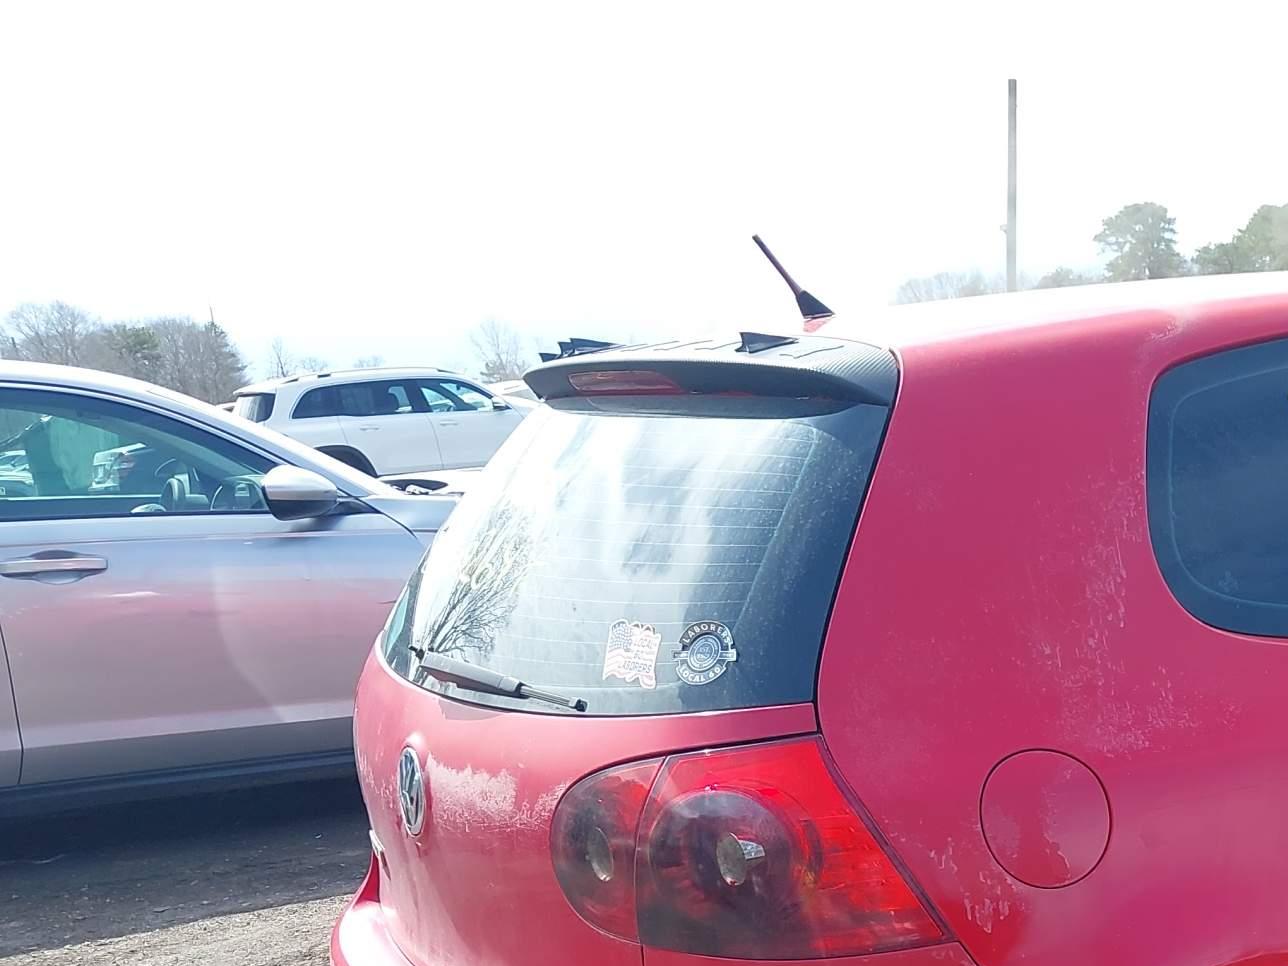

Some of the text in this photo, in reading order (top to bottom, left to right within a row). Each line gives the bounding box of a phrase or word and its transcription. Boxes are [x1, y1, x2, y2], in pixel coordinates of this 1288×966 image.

[682, 623, 731, 643] LABORERS
[680, 664, 721, 682] LOCAL 60
